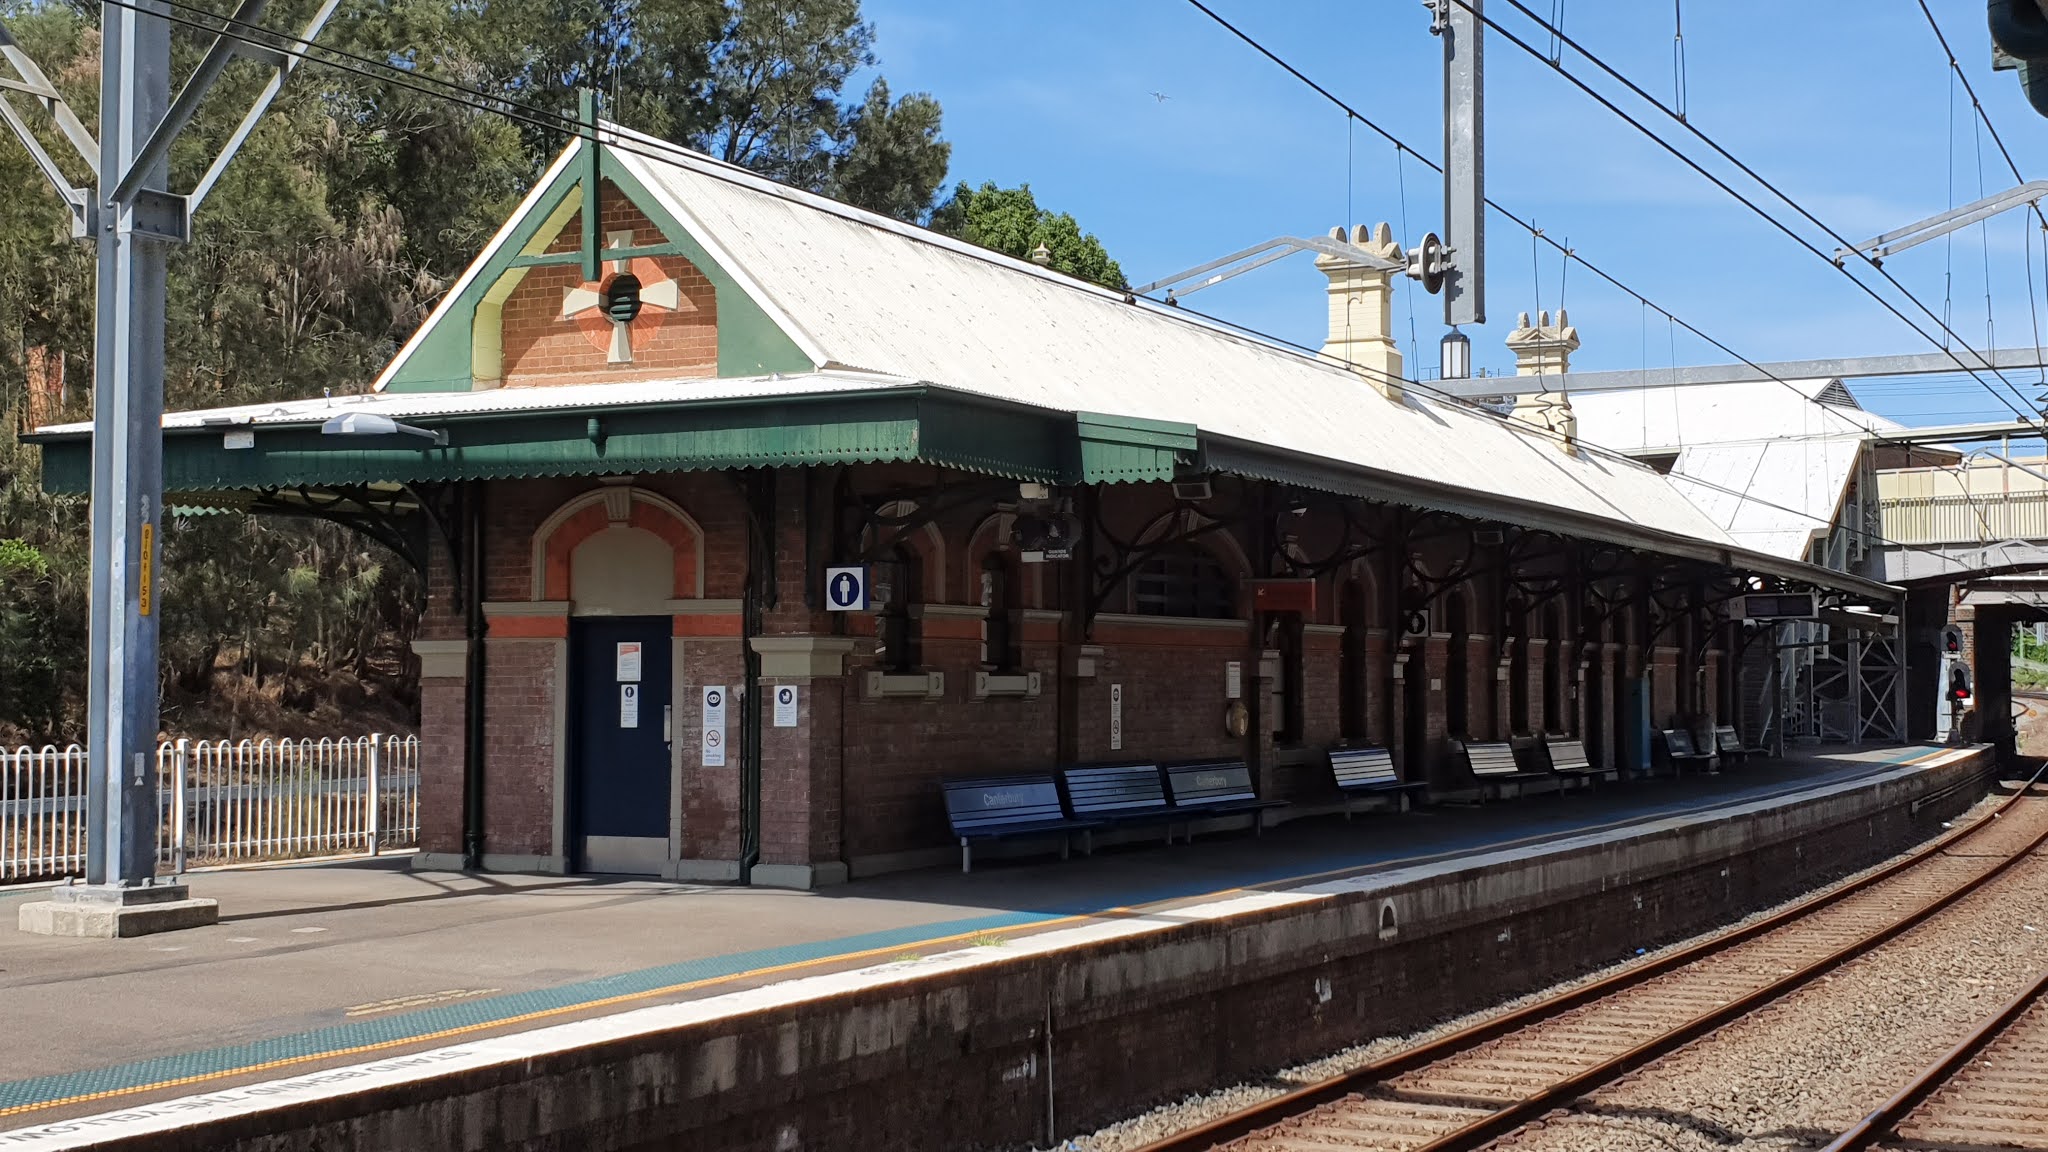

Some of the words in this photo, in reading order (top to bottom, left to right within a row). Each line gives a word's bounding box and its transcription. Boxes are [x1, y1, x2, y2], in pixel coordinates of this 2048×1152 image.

[365, 1050, 473, 1073] STAND
[248, 1070, 366, 1096] BEHIND
[166, 1094, 249, 1111] THE
[7, 1109, 166, 1142] YELLOW
